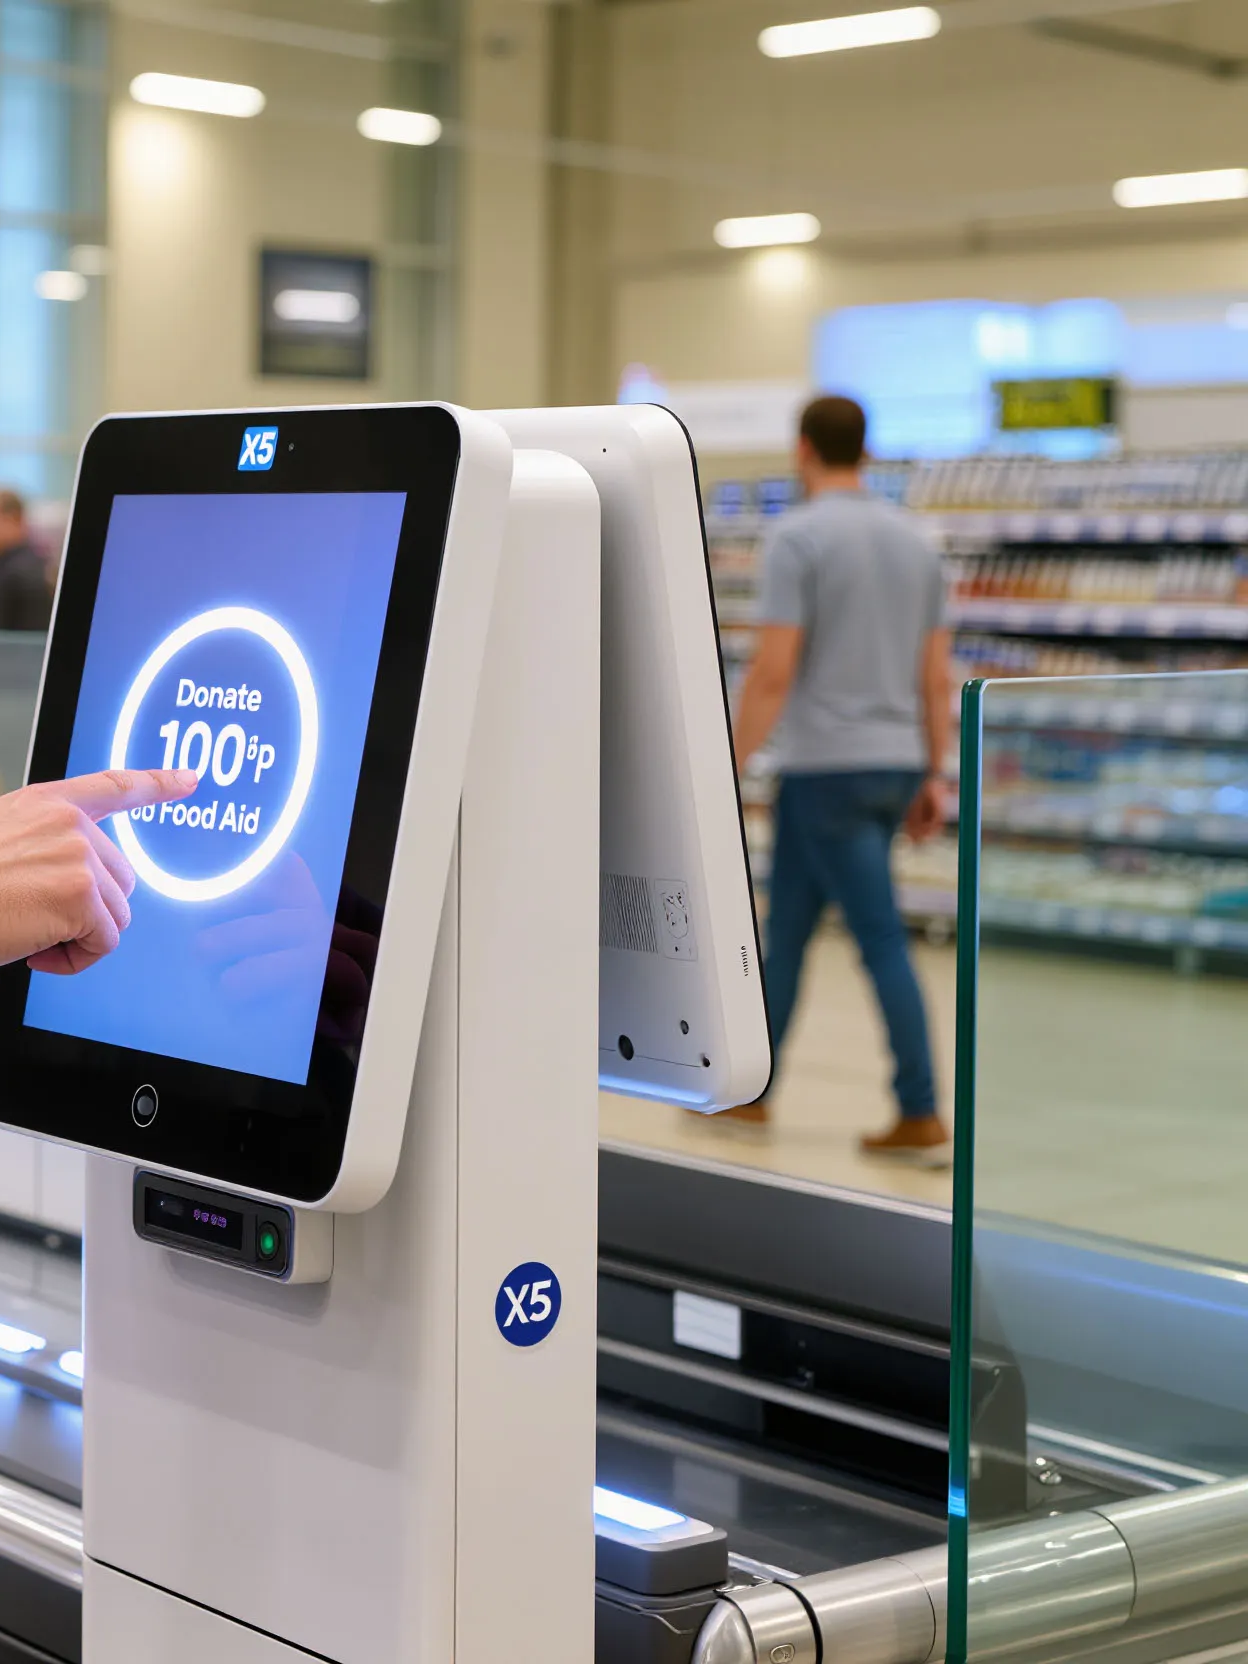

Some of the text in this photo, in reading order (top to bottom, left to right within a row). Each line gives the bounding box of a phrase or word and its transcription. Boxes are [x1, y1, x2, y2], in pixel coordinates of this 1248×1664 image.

[240, 431, 276, 466] X5
[176, 678, 262, 712] Donate
[159, 801, 219, 830] Food
[219, 802, 261, 835] Aid
[503, 1279, 552, 1328] X5
